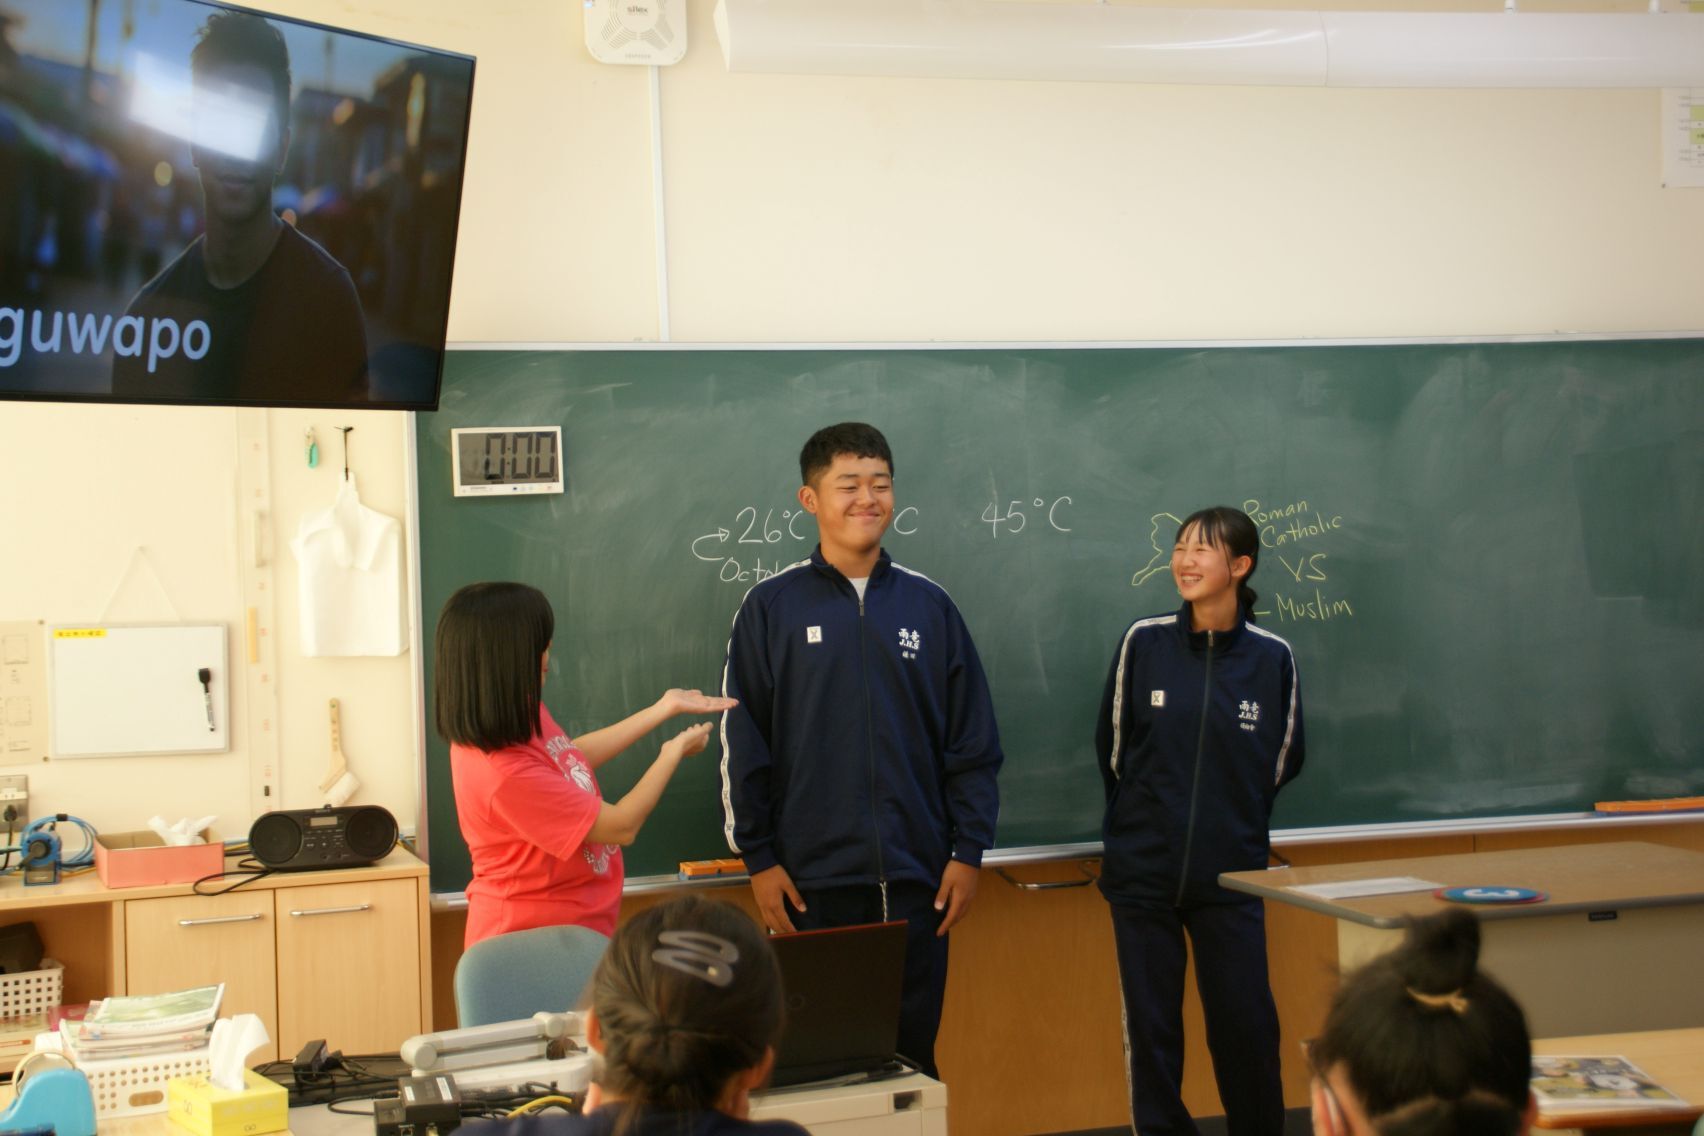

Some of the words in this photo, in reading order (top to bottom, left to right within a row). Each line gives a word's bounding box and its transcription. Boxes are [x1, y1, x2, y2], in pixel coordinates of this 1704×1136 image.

[0, 307, 211, 373] guwapo
[893, 506, 919, 535] C
[981, 496, 1072, 539] 45°C
[1243, 499, 1308, 527] Roman
[1260, 512, 1343, 548] Catholic
[1275, 588, 1353, 623] Muslim
